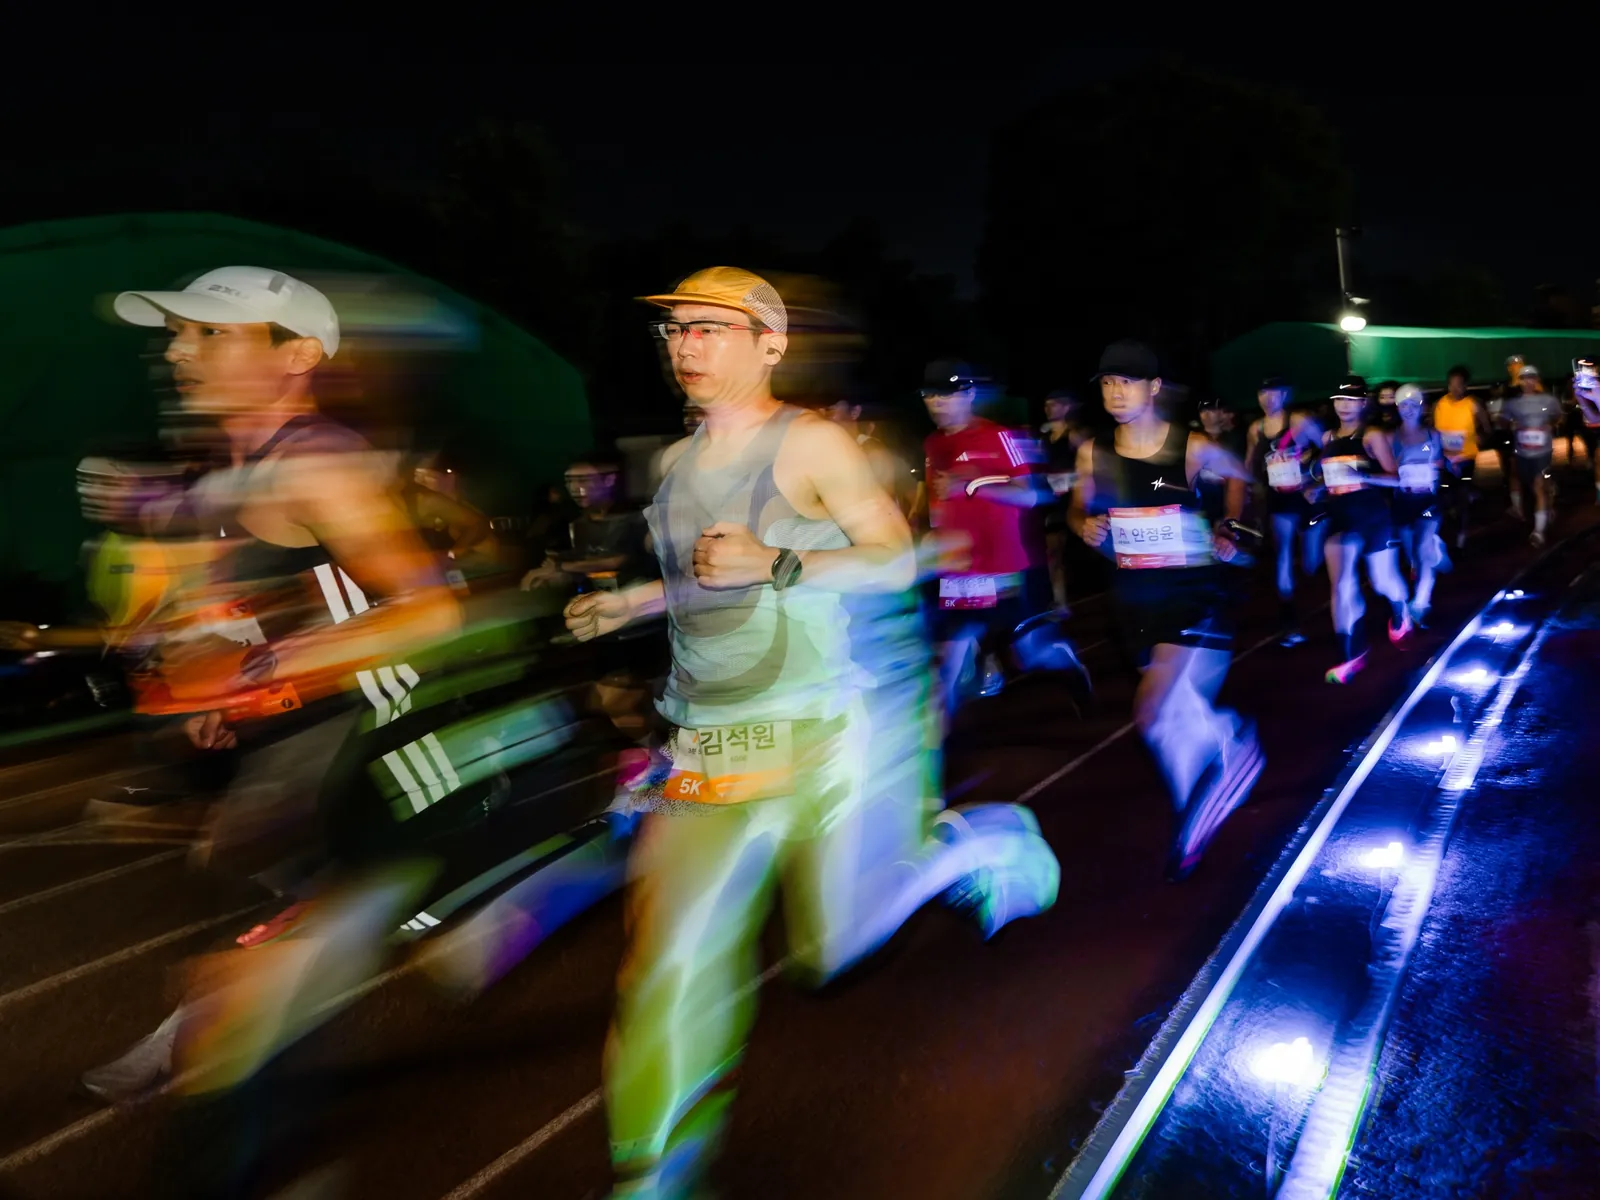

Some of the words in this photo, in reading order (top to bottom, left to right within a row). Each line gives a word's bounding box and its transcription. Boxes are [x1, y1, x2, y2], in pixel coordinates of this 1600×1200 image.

[1132, 526, 1174, 543] 안정윤
[945, 599, 956, 608] 5K
[700, 723, 775, 756] 김석원
[679, 778, 703, 796] 5K
